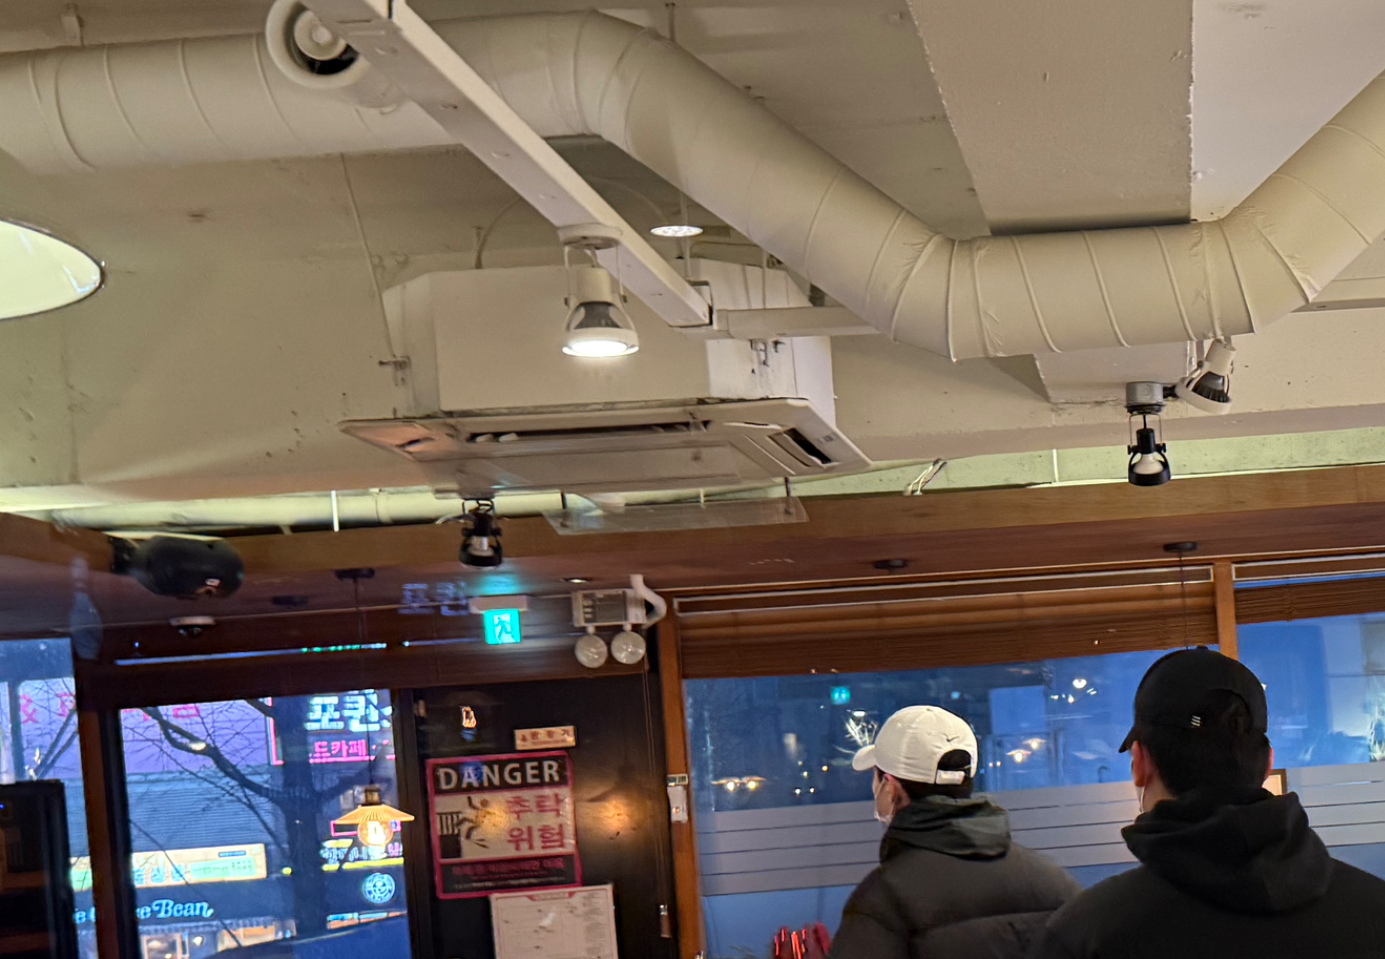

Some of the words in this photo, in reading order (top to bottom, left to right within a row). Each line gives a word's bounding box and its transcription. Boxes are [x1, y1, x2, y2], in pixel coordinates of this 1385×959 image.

[304, 689, 393, 733] 포퀸
[309, 739, 368, 759] 드카페
[437, 760, 561, 791] DANGER
[506, 792, 565, 821] 추락
[507, 823, 566, 852] 위험
[153, 899, 214, 919] Bean
